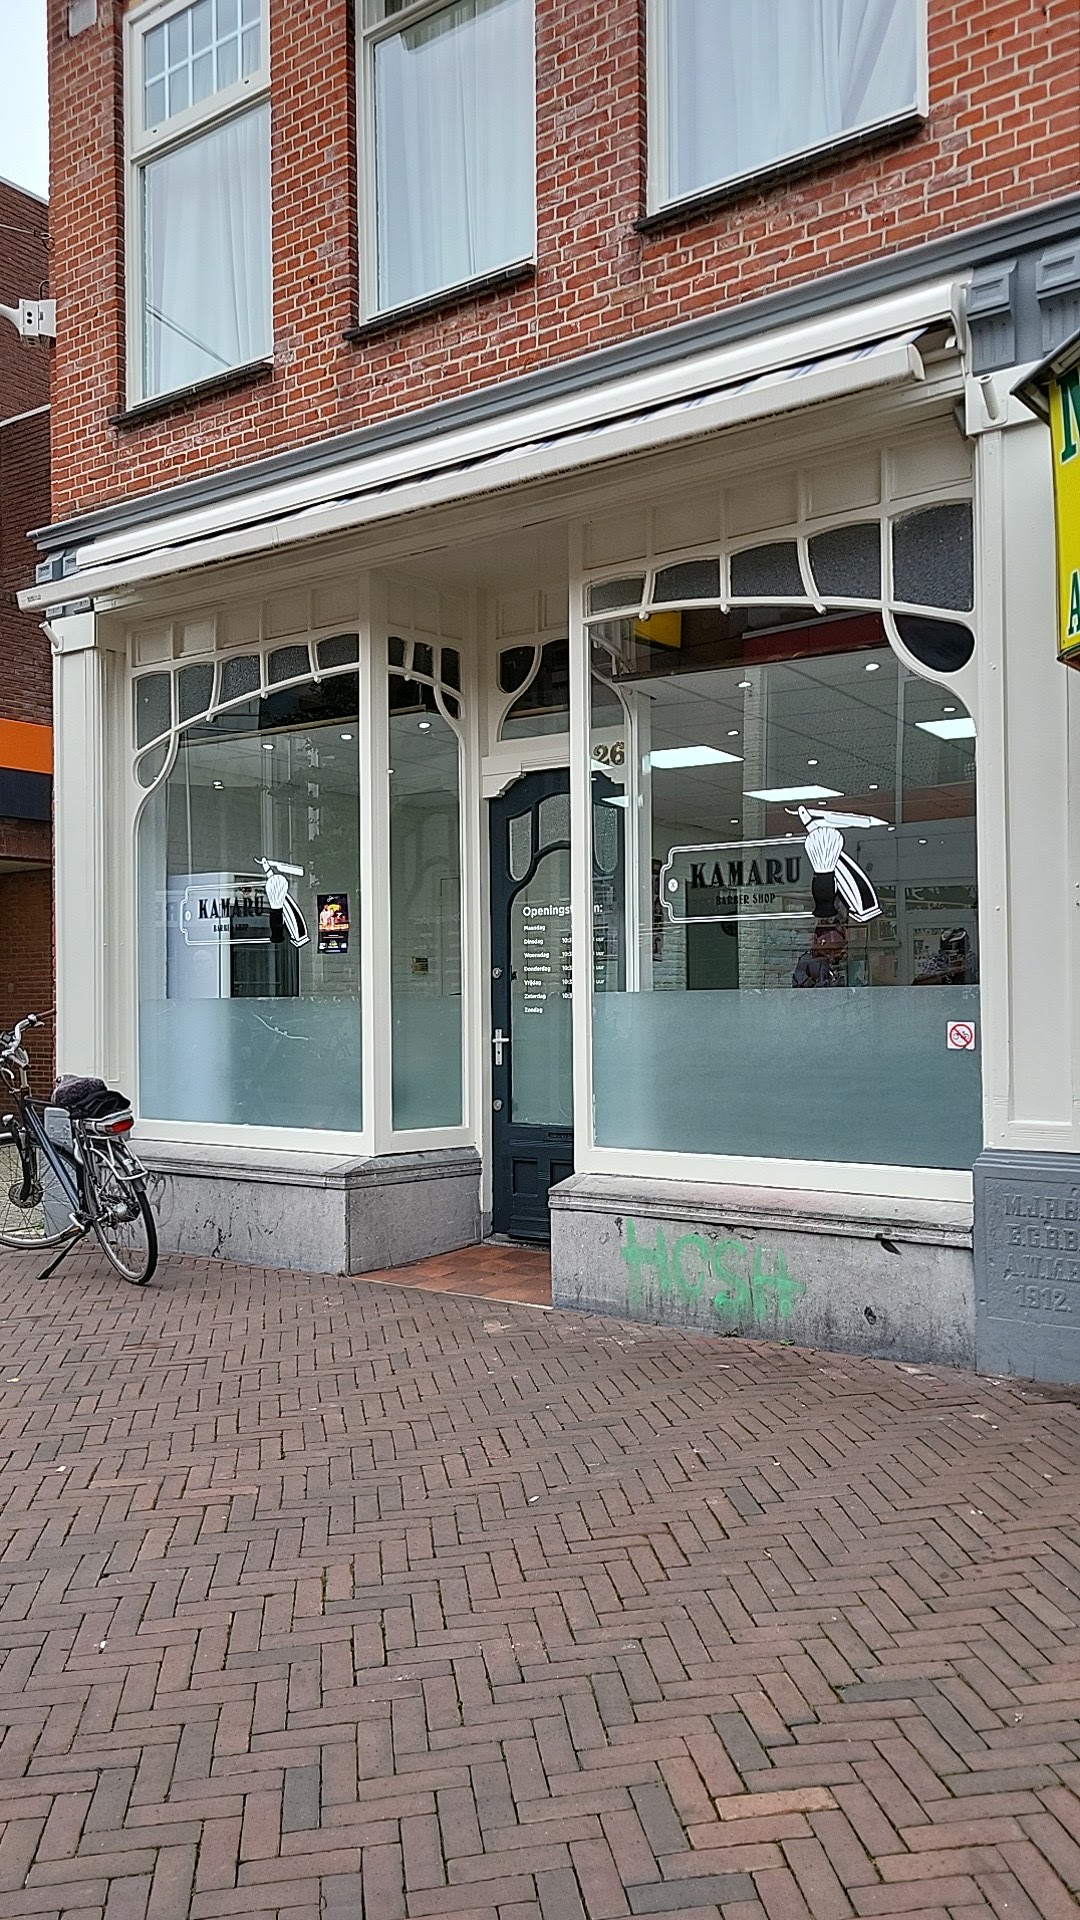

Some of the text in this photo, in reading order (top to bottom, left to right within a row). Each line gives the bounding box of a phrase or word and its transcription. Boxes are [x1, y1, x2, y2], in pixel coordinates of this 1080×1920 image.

[593, 742, 625, 766] 26
[690, 856, 801, 889] KAMARU
[198, 895, 264, 920] KAMARU
[715, 892, 776, 905] BARBER SHOP
